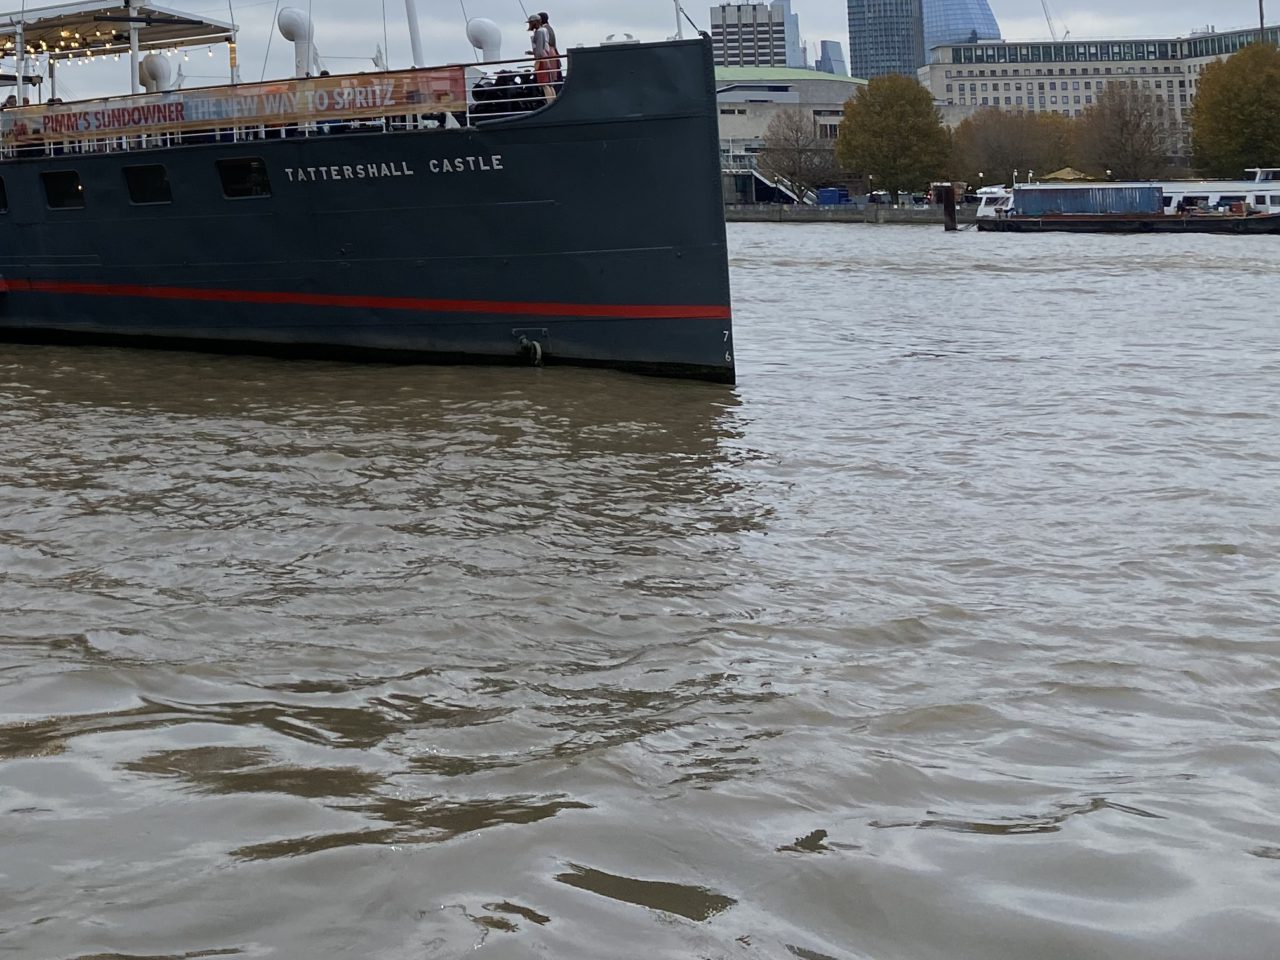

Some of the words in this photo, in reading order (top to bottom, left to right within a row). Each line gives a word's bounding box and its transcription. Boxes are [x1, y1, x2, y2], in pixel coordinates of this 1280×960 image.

[43, 110, 91, 133] PIMM'S
[94, 102, 185, 130] SUNDOWNER
[188, 99, 219, 120] THE
[221, 95, 257, 117] NEW
[263, 90, 302, 114] WAY
[305, 90, 328, 111] TO
[333, 83, 396, 109] SPRITZ
[285, 161, 414, 182] TATTERSHALL
[430, 155, 504, 173] CASTLE
[723, 330, 729, 342] 7
[725, 351, 732, 362] 6
